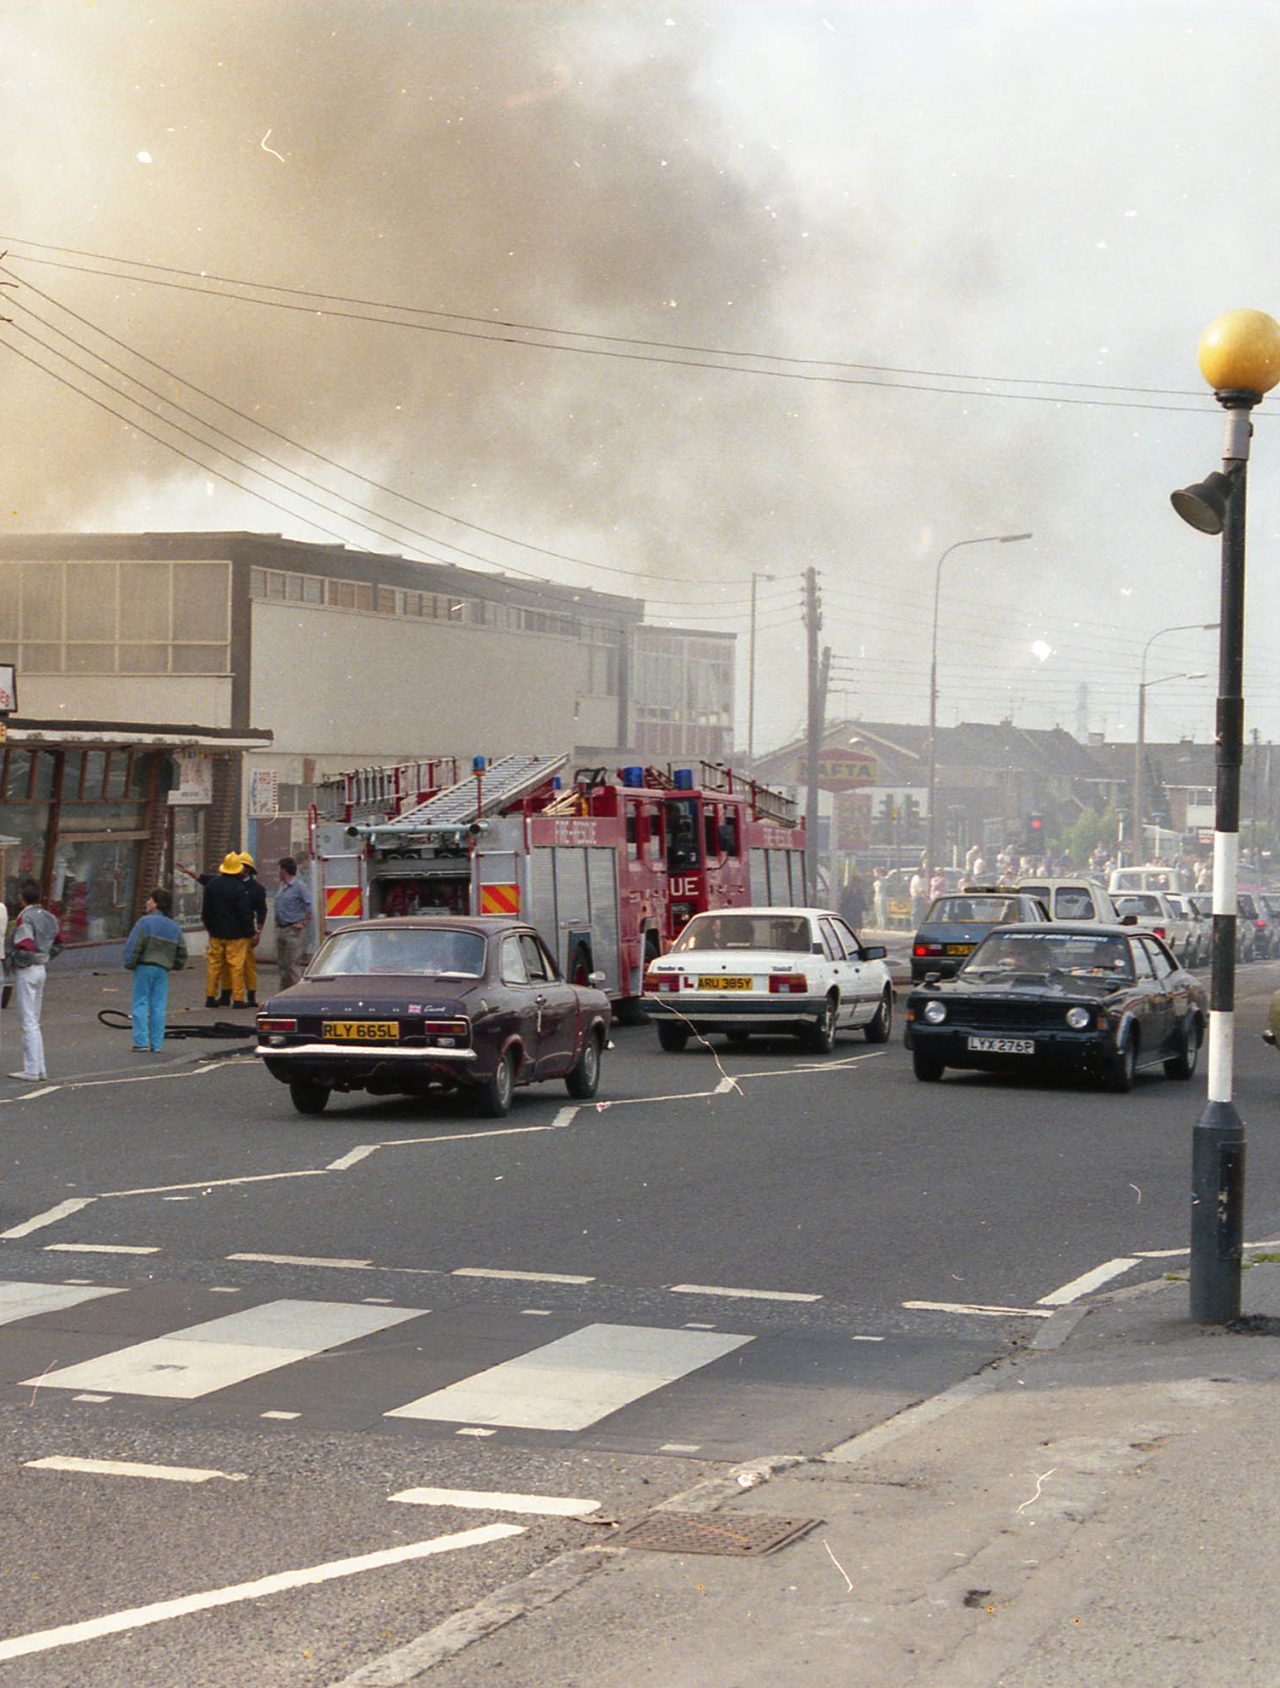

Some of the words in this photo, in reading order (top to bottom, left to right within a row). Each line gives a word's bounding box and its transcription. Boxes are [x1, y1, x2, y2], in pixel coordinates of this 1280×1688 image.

[698, 977, 720, 988] ARU
[721, 977, 752, 989] 385Y
[323, 1024, 353, 1038] RLY
[356, 1024, 398, 1038] 665L
[970, 1037, 997, 1050] LYX
[998, 1039, 1034, 1053] 276P
